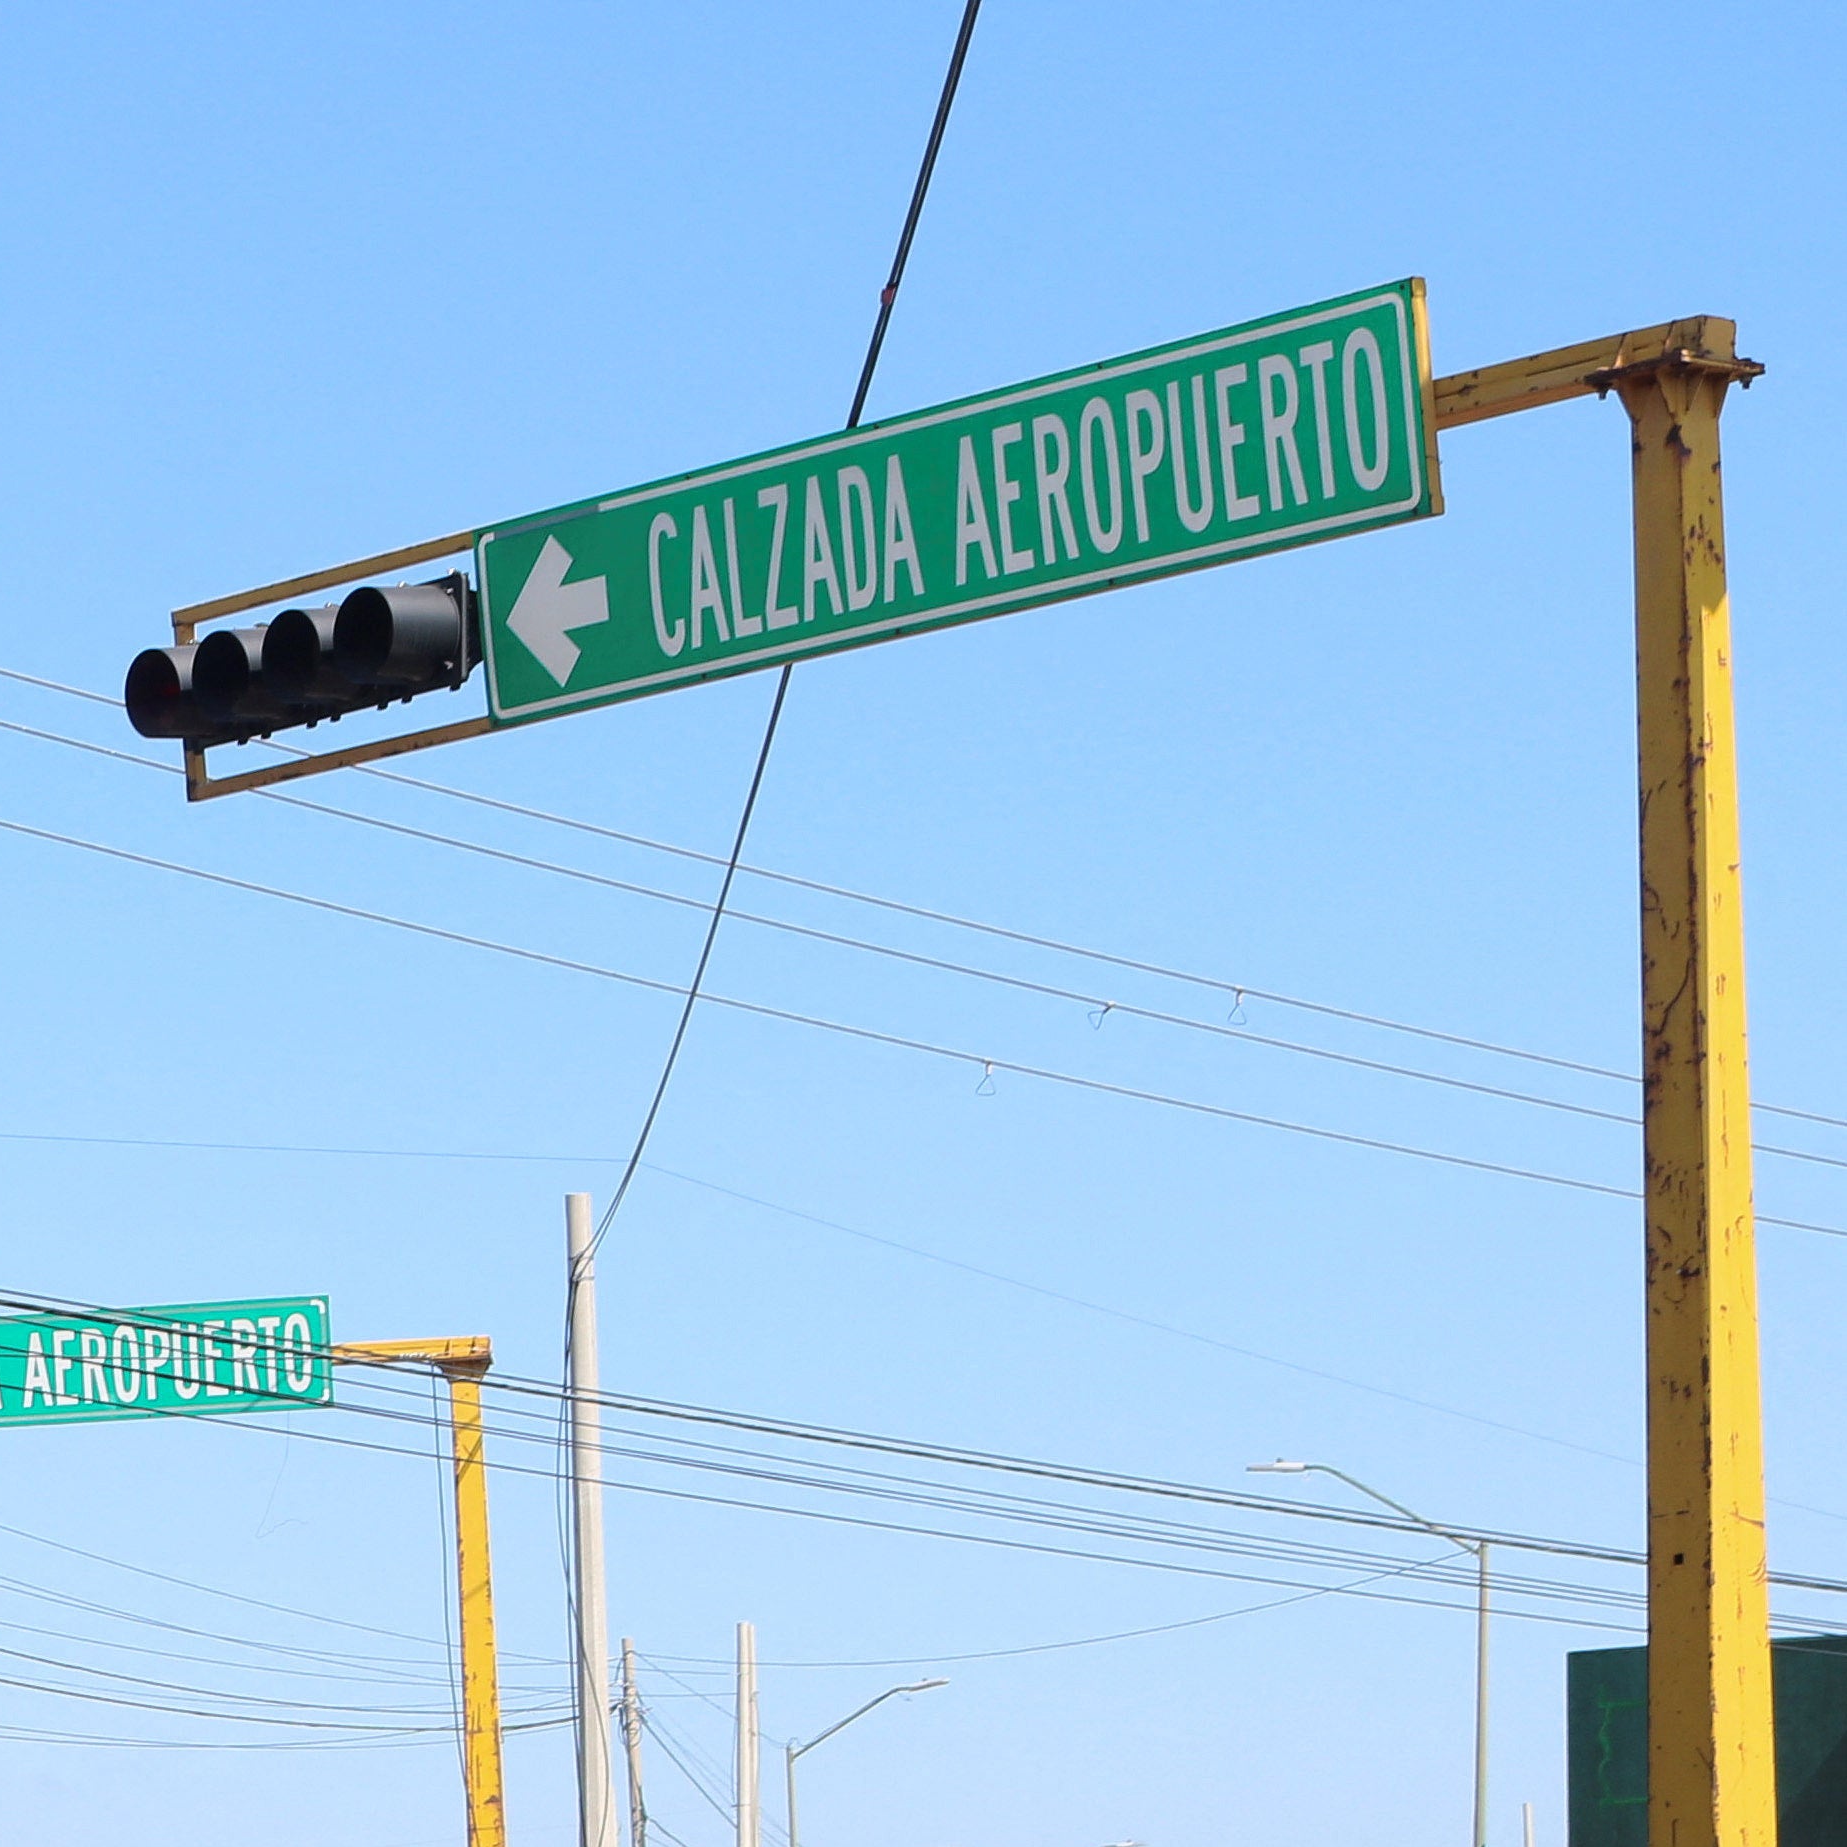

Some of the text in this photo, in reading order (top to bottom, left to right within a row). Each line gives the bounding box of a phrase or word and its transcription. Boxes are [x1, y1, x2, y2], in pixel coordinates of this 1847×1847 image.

[647, 326, 1390, 658] CALZADA AEROPUERTO
[24, 1311, 314, 1408] AEROPUERTO
